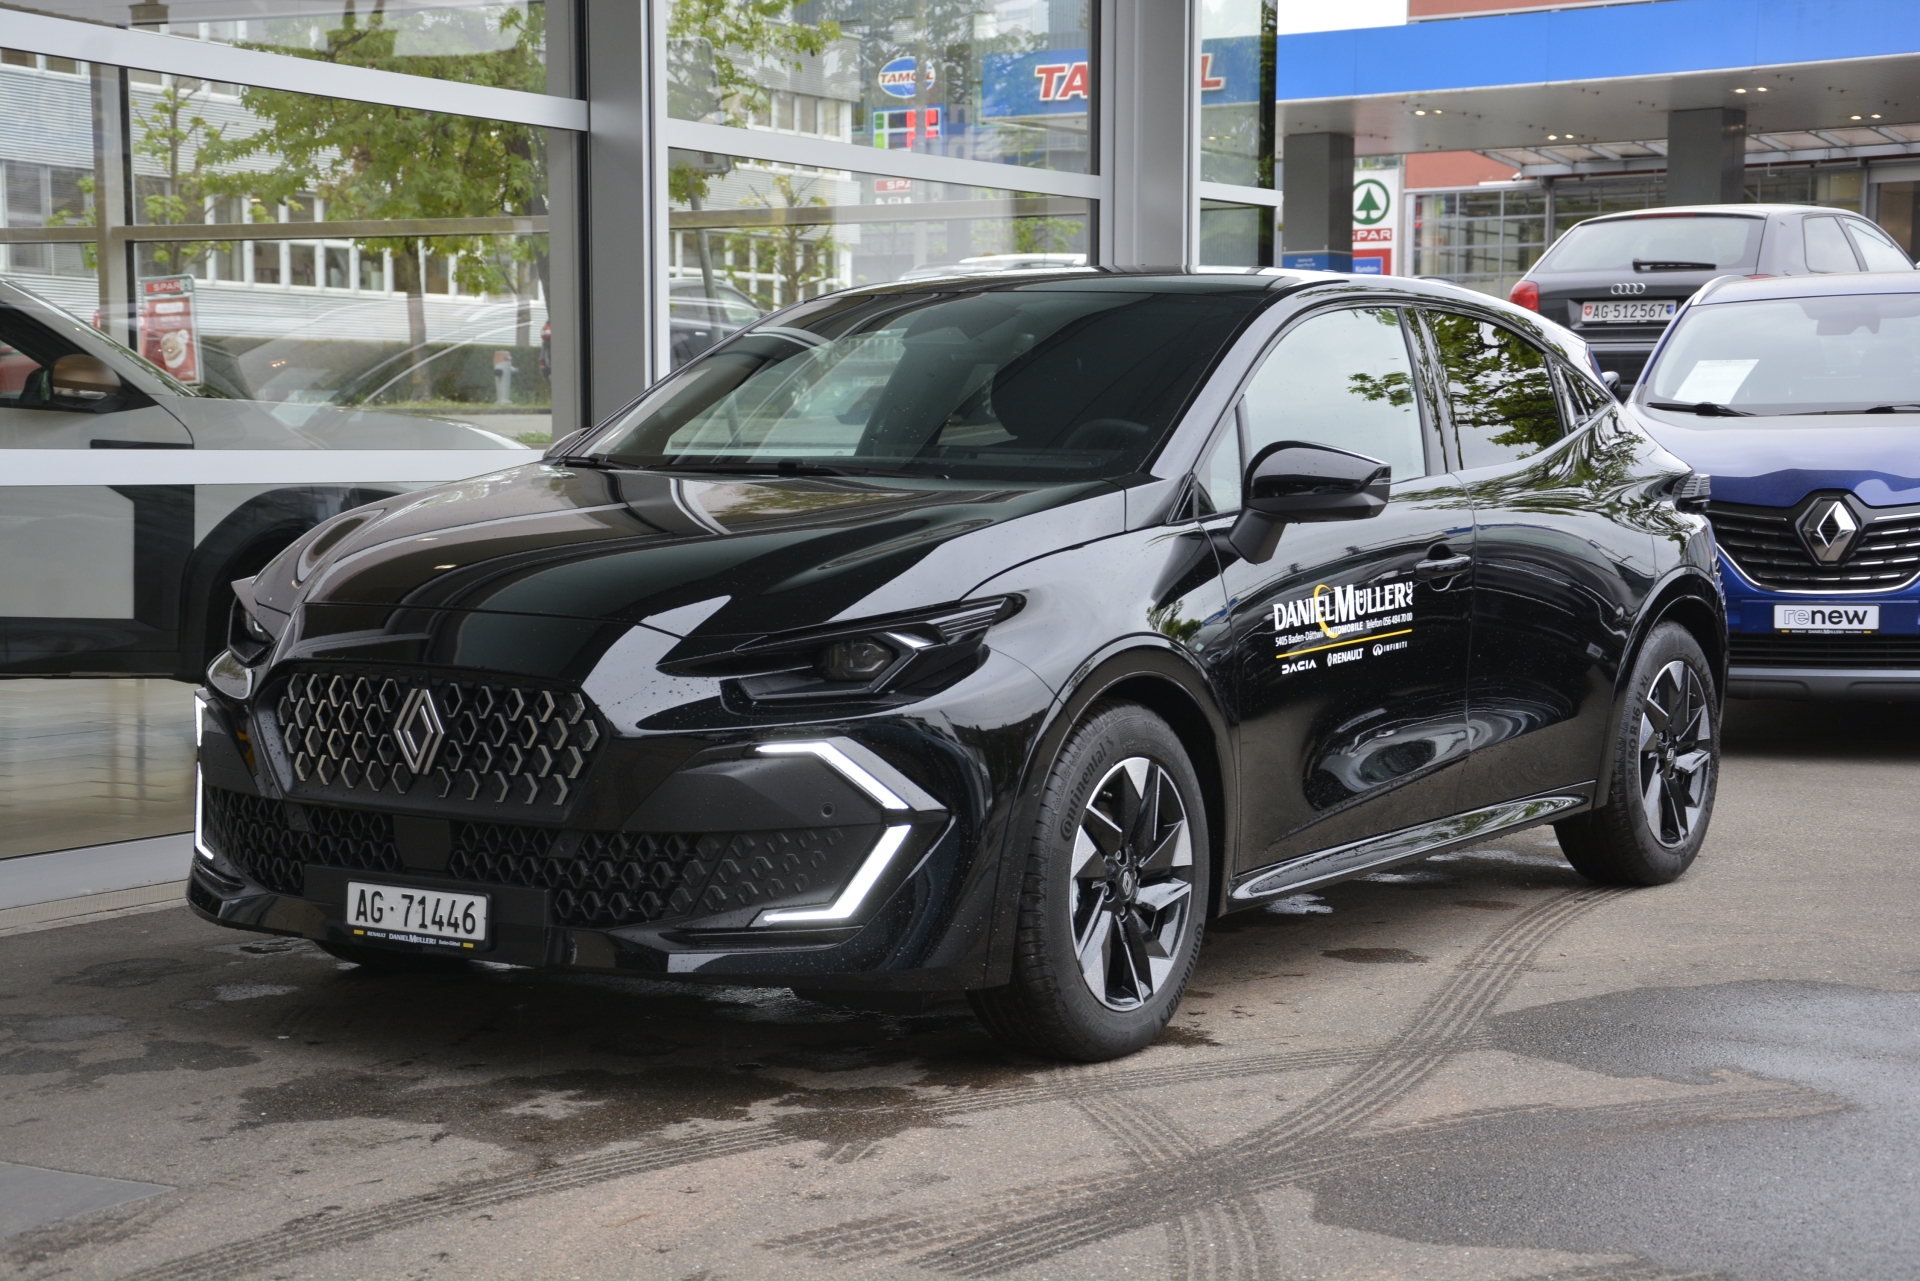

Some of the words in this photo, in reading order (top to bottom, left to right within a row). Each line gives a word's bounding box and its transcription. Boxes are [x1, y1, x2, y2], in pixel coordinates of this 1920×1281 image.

[153, 281, 181, 293] SPAR
[1405, 580, 1414, 606] AG
[1783, 609, 1868, 625] renew
[1275, 635, 1288, 648] 5405
[1326, 621, 1364, 637] AUTOMOBILE
[1365, 617, 1383, 630] Telefon
[1383, 641, 1408, 653] INFINITI
[1332, 648, 1364, 665] RENAULT
[1281, 659, 1317, 675] DACIA
[1060, 742, 1108, 842] Continental
